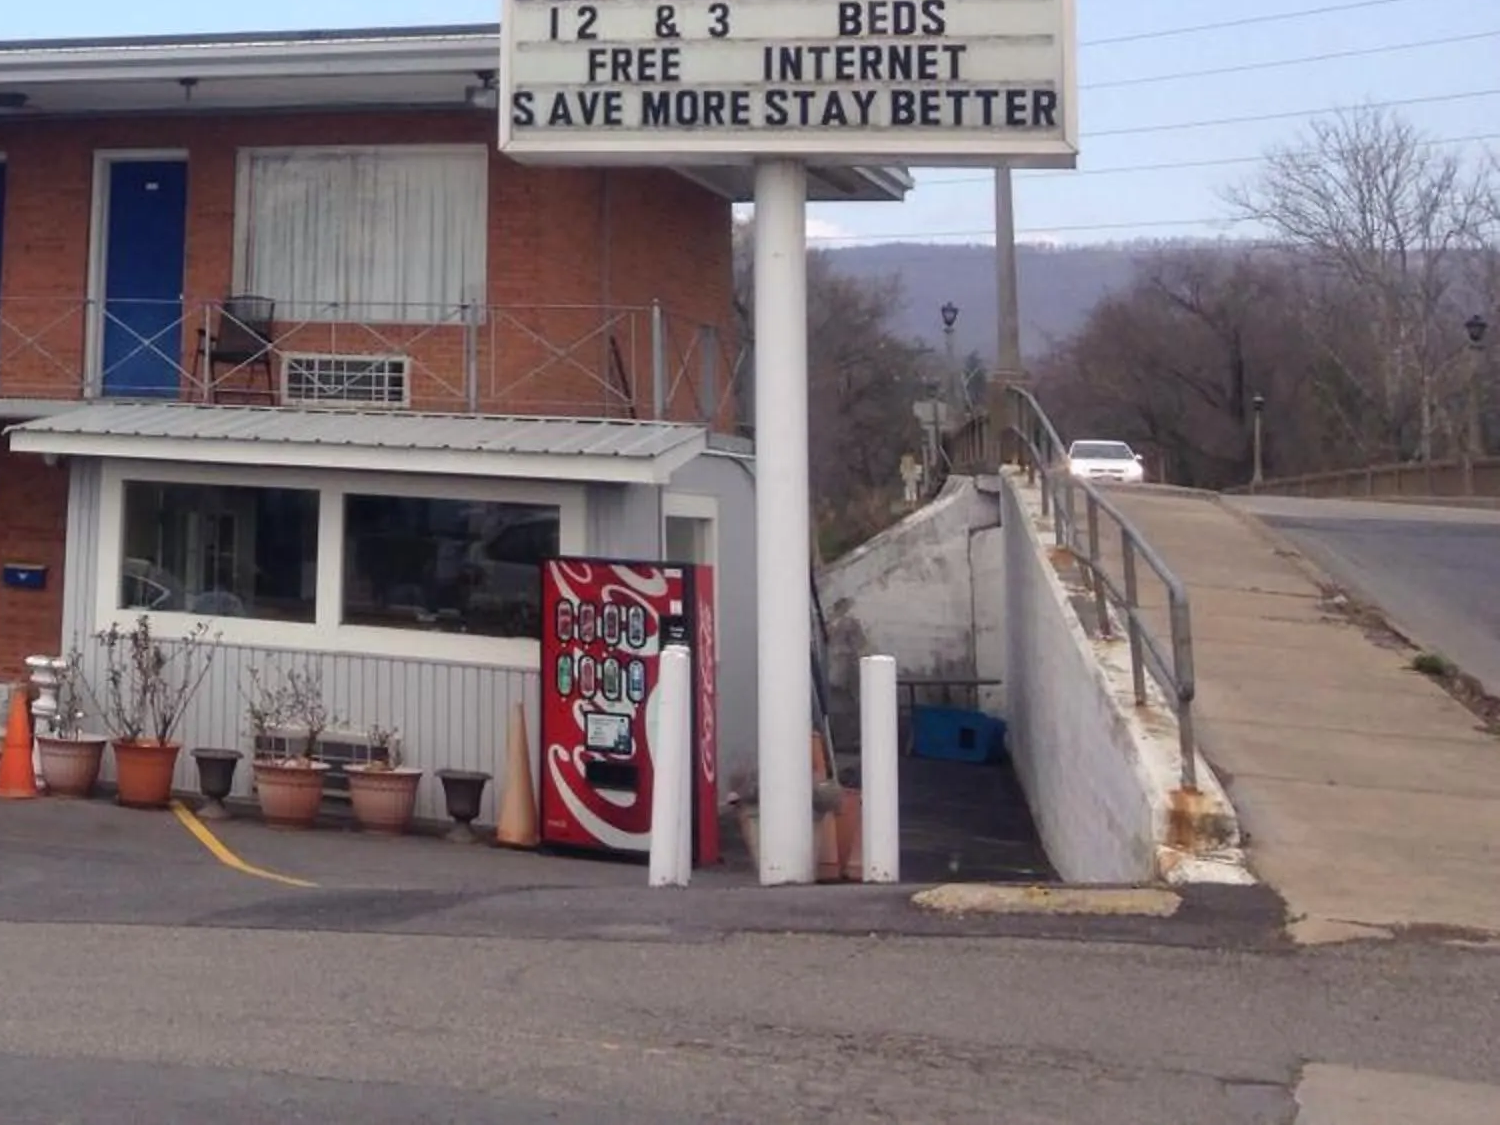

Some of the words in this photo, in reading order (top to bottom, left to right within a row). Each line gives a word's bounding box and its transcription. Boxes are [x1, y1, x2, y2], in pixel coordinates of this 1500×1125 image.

[655, 4, 681, 40] &
[708, 2, 730, 39] 3
[588, 47, 680, 84] FREE
[764, 44, 967, 83] INTERNET
[512, 90, 623, 128] SAVE
[641, 89, 751, 129] MORE
[764, 89, 877, 128] STAY
[890, 89, 1057, 129] BETTER
